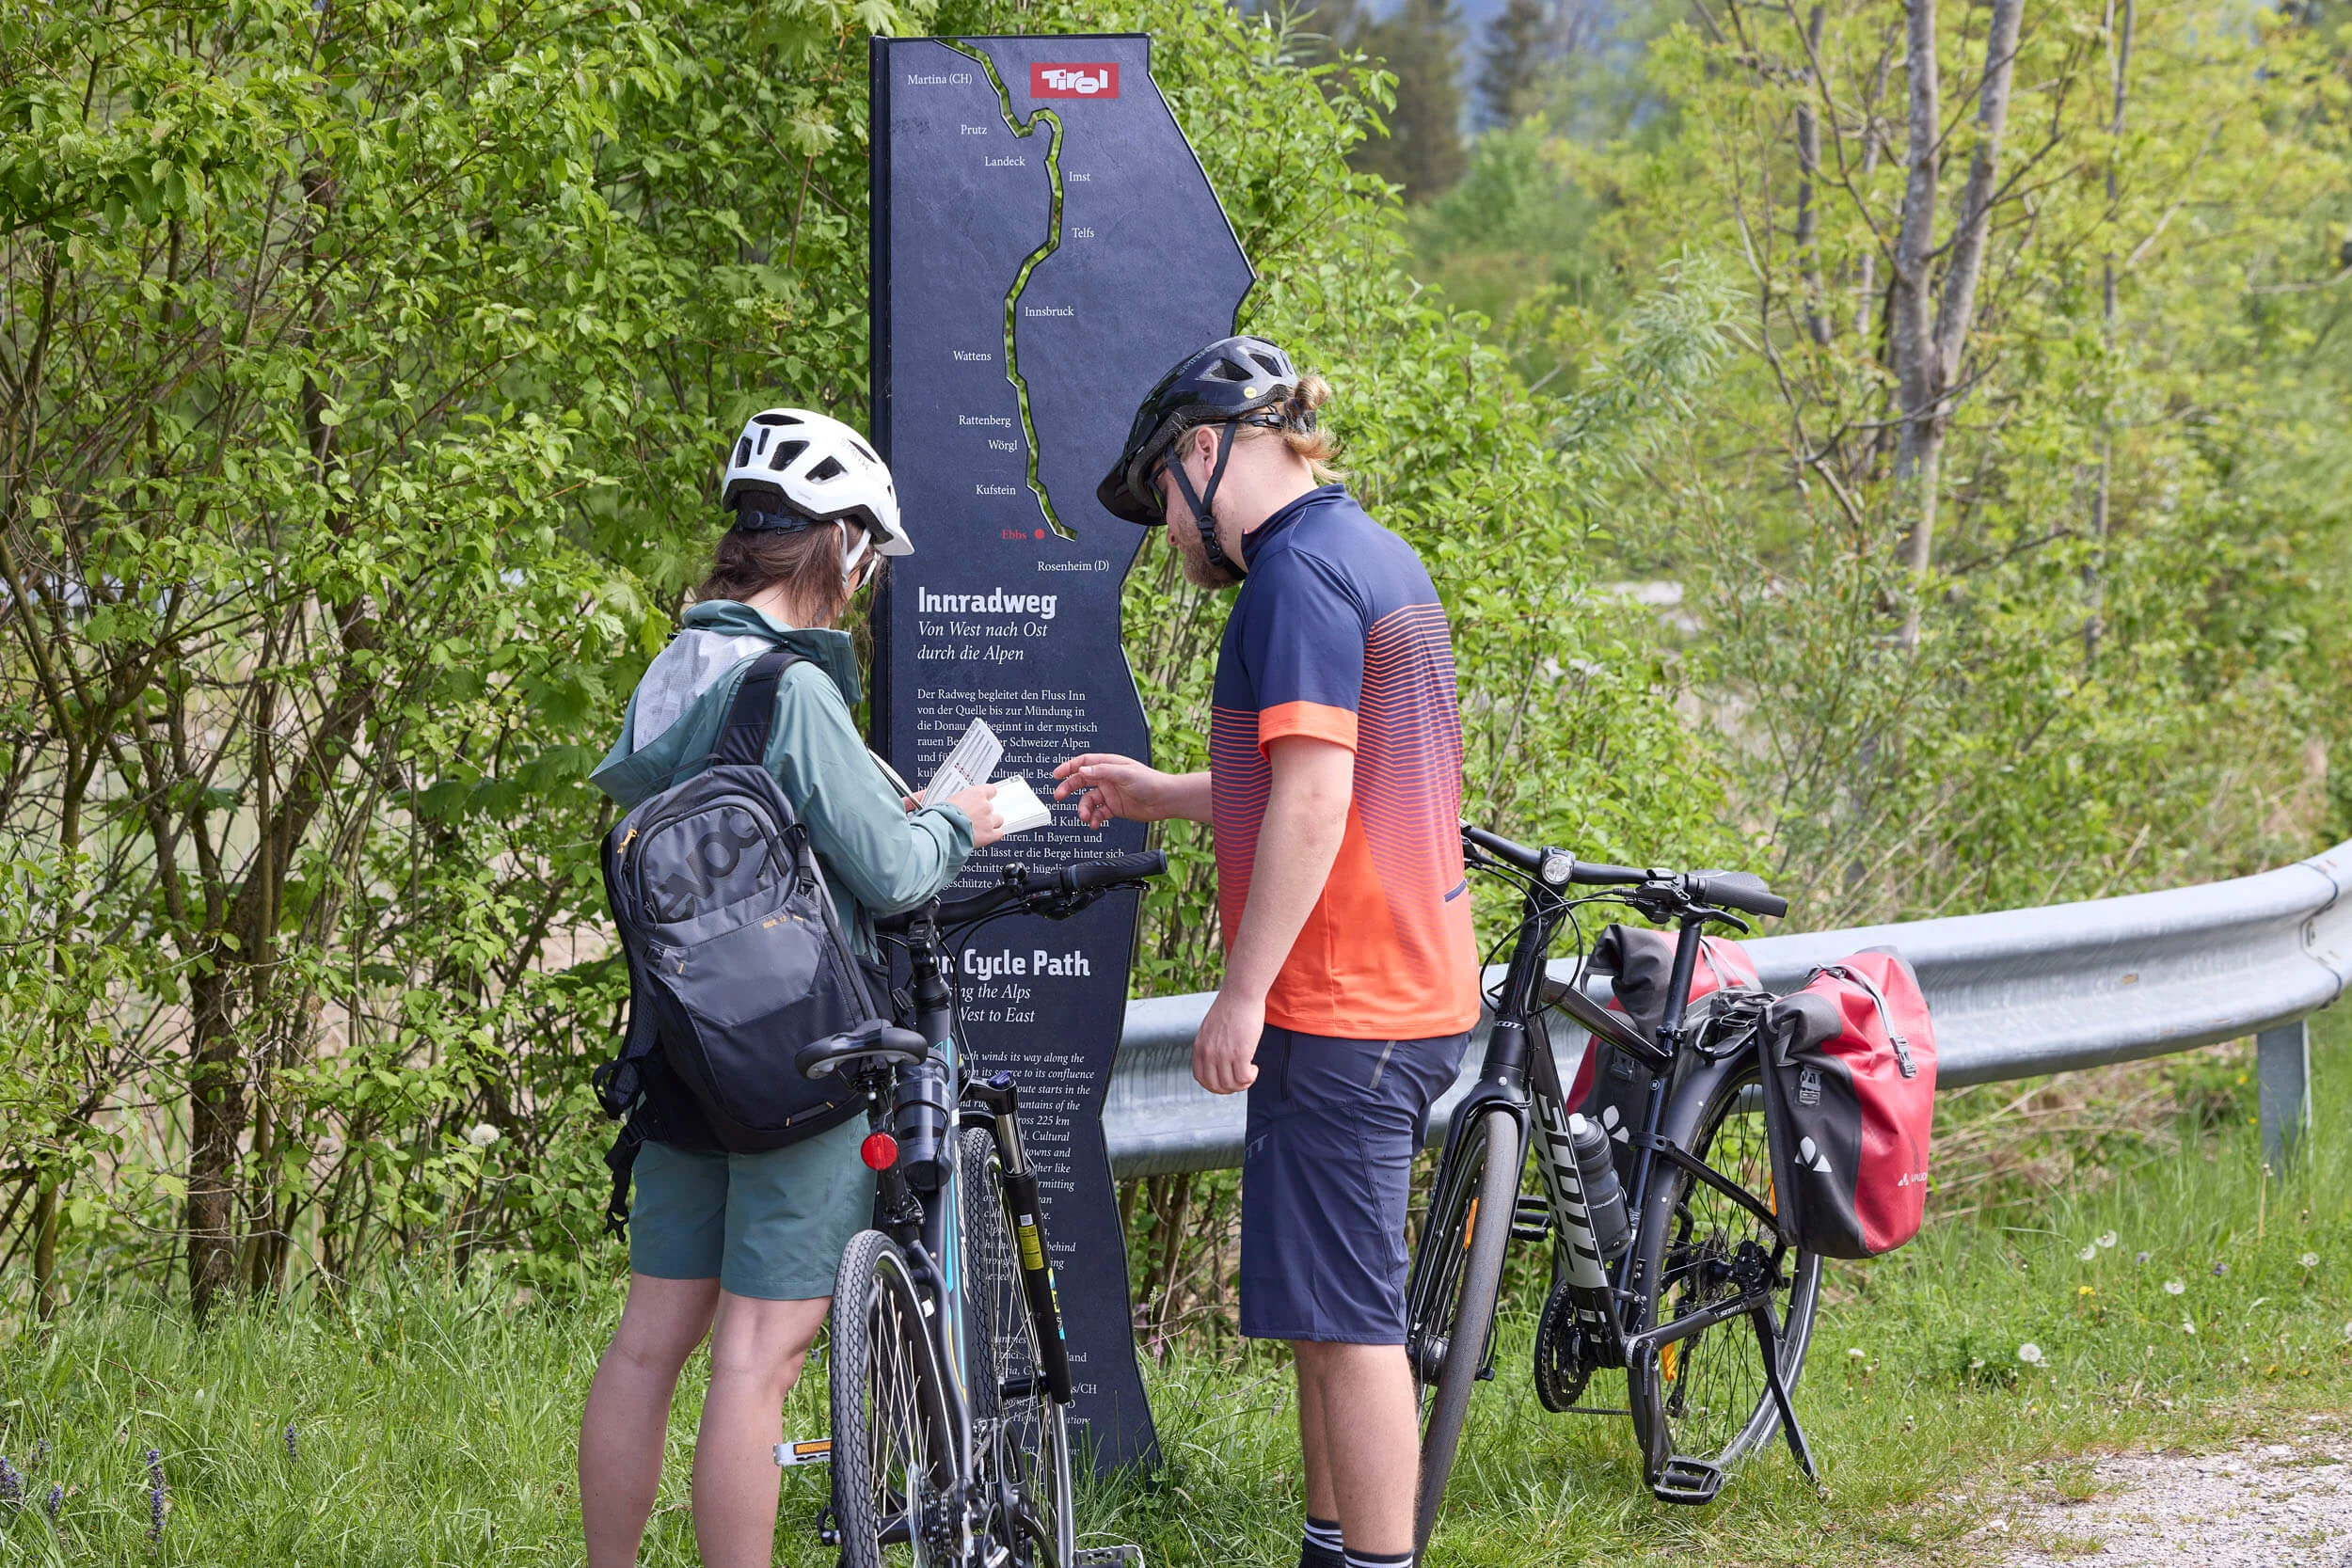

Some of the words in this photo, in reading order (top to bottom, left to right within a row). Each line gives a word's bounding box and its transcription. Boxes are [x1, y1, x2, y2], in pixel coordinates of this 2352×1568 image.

[908, 74, 946, 85] Martina
[949, 73, 972, 85] (CH)
[961, 125, 987, 135] Prutz
[985, 156, 1025, 166] Landeck
[1070, 171, 1090, 181] Imst
[1072, 228, 1094, 238] Telfs
[1025, 306, 1073, 316] Innsbruck
[954, 351, 991, 360] Wattens
[960, 415, 1011, 428] Rattenberg
[989, 440, 1017, 452] Wörgl
[977, 484, 1015, 495] Kufstein
[1003, 530, 1025, 538] Ebbs
[1039, 561, 1091, 571] Rosenheim
[1095, 561, 1109, 572] (D)
[919, 587, 1057, 619] Innradweg
[919, 621, 943, 636] Von
[950, 622, 980, 636] West
[986, 622, 1017, 636] nach
[1024, 622, 1048, 636] Ost
[917, 644, 954, 659] durch
[961, 645, 979, 659] die
[983, 645, 1024, 664] Alpen
[918, 689, 935, 698] Der
[939, 689, 976, 702] Radweg
[978, 689, 1018, 702] begleitet
[1021, 689, 1038, 699] den
[1042, 690, 1065, 700] Fluss
[1069, 690, 1085, 700] Inn
[938, 705, 953, 714] der
[956, 705, 986, 718] Quelle
[990, 705, 1002, 715] bis
[1025, 705, 1073, 719] Mündung
[1075, 707, 1085, 716] in
[917, 721, 931, 730] die
[1038, 721, 1053, 731] der
[1056, 722, 1097, 734] mystisch
[1010, 737, 1058, 747] Schweizer
[1061, 737, 1089, 750] Alpen
[918, 752, 935, 761] und
[1005, 752, 1032, 762] durch
[1036, 753, 1050, 763] die
[1060, 816, 1089, 828] Kultu
[1035, 832, 1043, 842] In
[1048, 832, 1080, 844] Bayern
[1084, 832, 1102, 842] und
[992, 847, 1011, 857] lässt
[1026, 847, 1041, 857] die
[1044, 848, 1071, 861] Berge
[1074, 848, 1104, 858] hinter
[964, 949, 1025, 980] Cycle
[1034, 950, 1090, 975] Path
[978, 983, 997, 998] the
[1001, 984, 1030, 1003] Alps
[990, 1010, 1001, 1022] to
[1006, 1007, 1034, 1022] East
[982, 1052, 1008, 1061] winds
[1010, 1053, 1021, 1061] its
[1024, 1055, 1041, 1065] way
[1044, 1053, 1068, 1065] along
[1072, 1053, 1084, 1062] the
[982, 1068, 993, 1077] its
[1036, 1069, 1045, 1077] its
[1048, 1069, 1094, 1081] confluence
[1066, 1085, 1073, 1094] in
[1077, 1085, 1089, 1094] the
[1018, 1101, 1052, 1109] untains
[1056, 1100, 1065, 1112] of
[1067, 1101, 1080, 1110] the
[1037, 1116, 1053, 1125] 225
[1056, 1116, 1069, 1125] km
[1033, 1131, 1070, 1141] Cultural
[1054, 1148, 1071, 1157] and
[1055, 1163, 1071, 1173] like
[1039, 1180, 1074, 1191] rmitting
